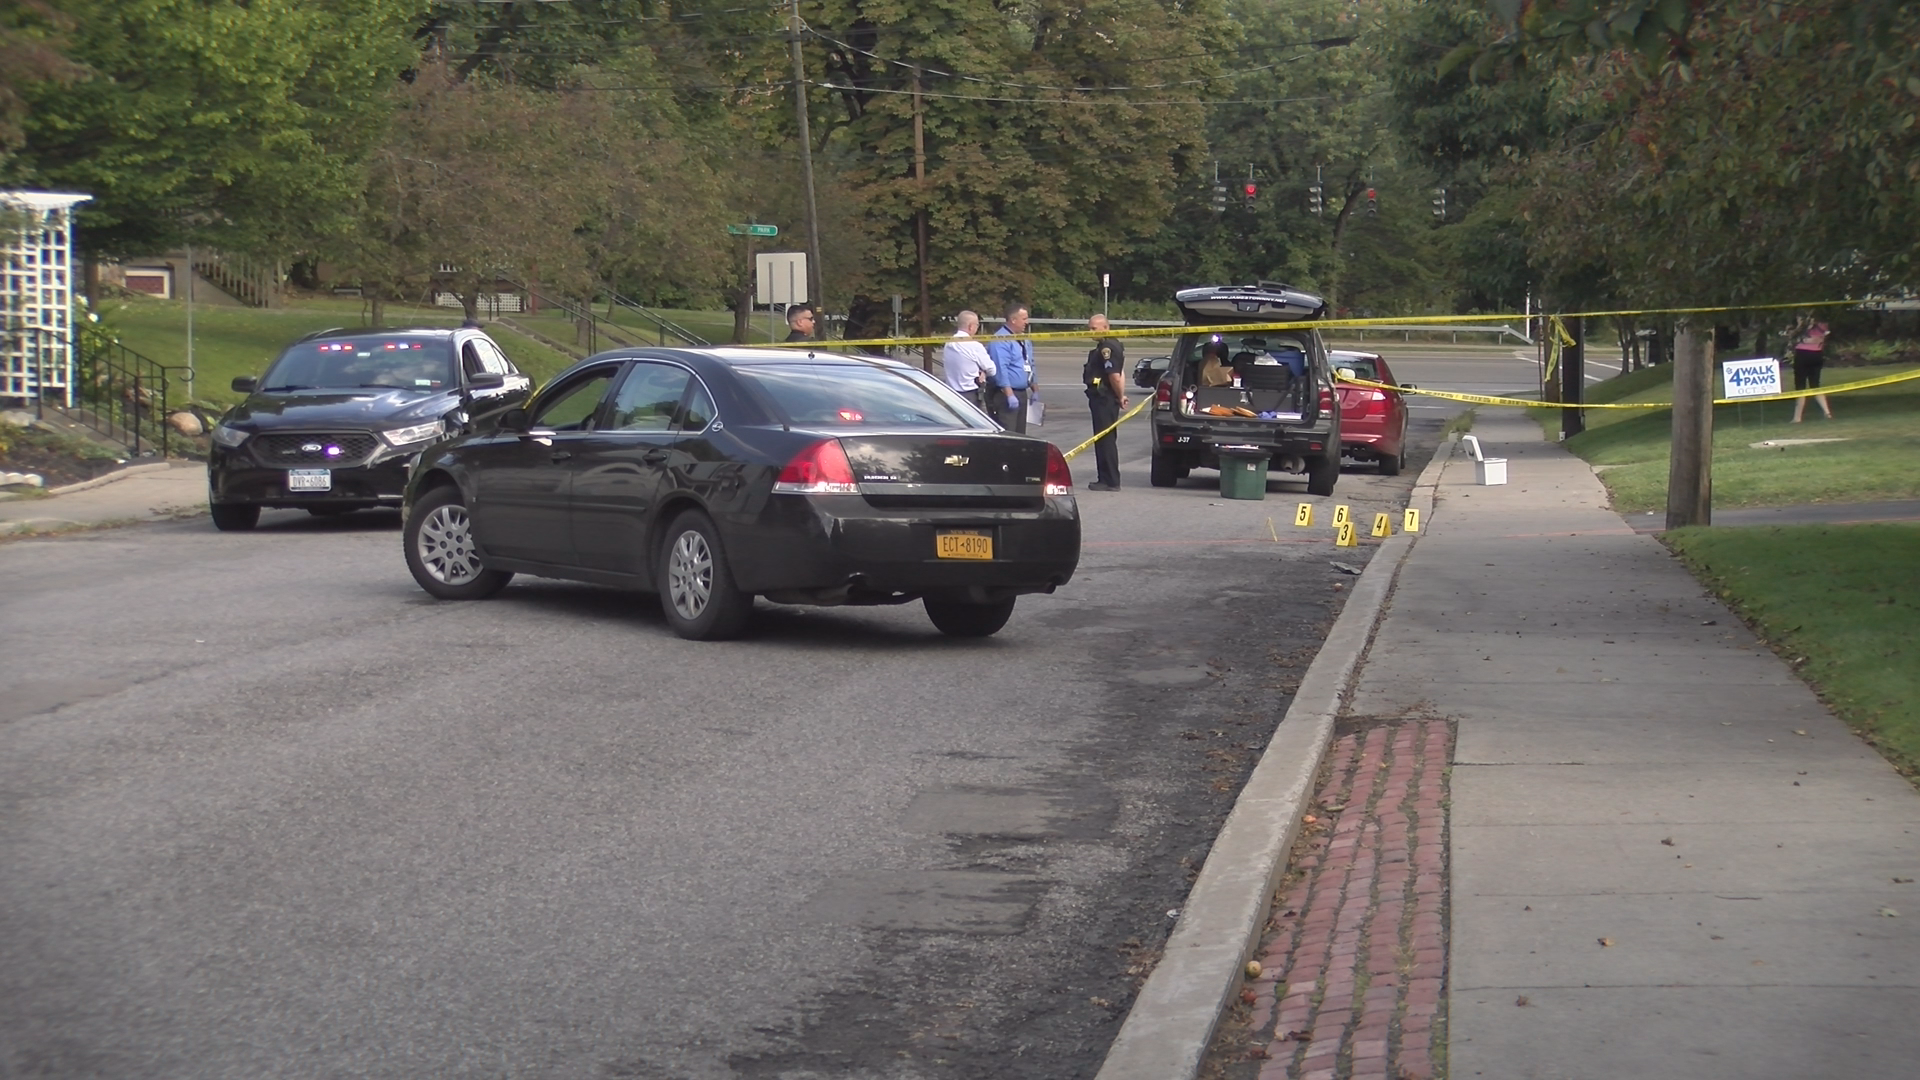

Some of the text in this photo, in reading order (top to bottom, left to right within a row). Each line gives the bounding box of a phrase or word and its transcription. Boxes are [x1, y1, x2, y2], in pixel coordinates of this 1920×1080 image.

[1728, 367, 1743, 387] 4
[1740, 364, 1774, 376] WALK
[1744, 374, 1776, 387] PAWS
[1299, 505, 1307, 521] 5
[1336, 507, 1344, 522] 6
[1408, 511, 1415, 527] 7
[1376, 515, 1384, 532] 4
[1341, 524, 1349, 541] 3
